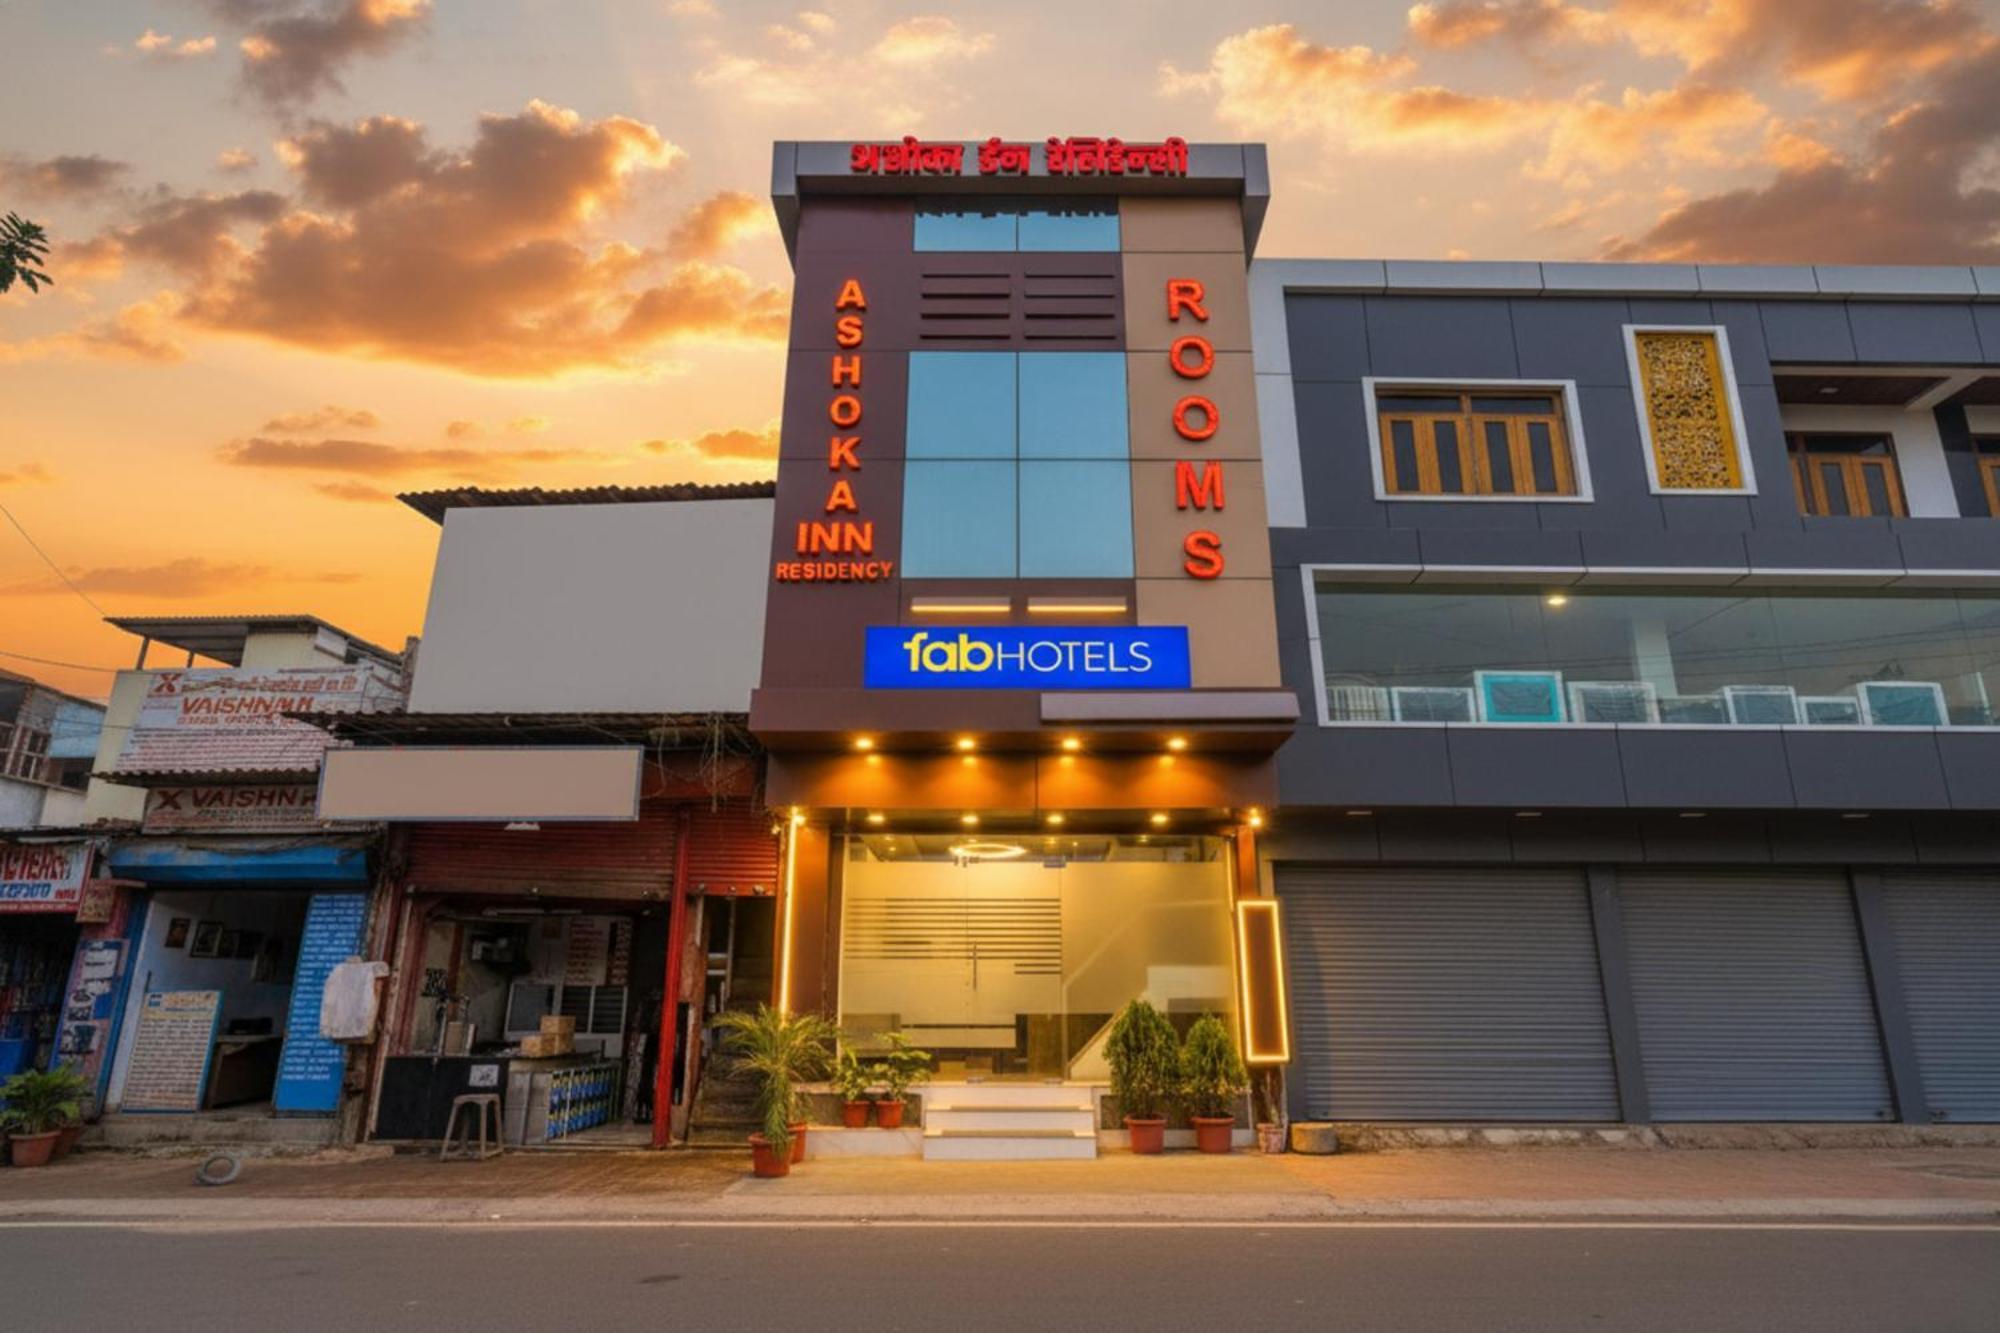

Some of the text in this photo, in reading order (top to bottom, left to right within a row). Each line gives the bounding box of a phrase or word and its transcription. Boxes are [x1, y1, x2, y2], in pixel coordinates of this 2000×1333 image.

[825, 278, 867, 513] ASHOKA
[1165, 277, 1226, 580] ROOMS
[775, 561, 893, 582] RESIDENCY
[795, 520, 875, 556] INN
